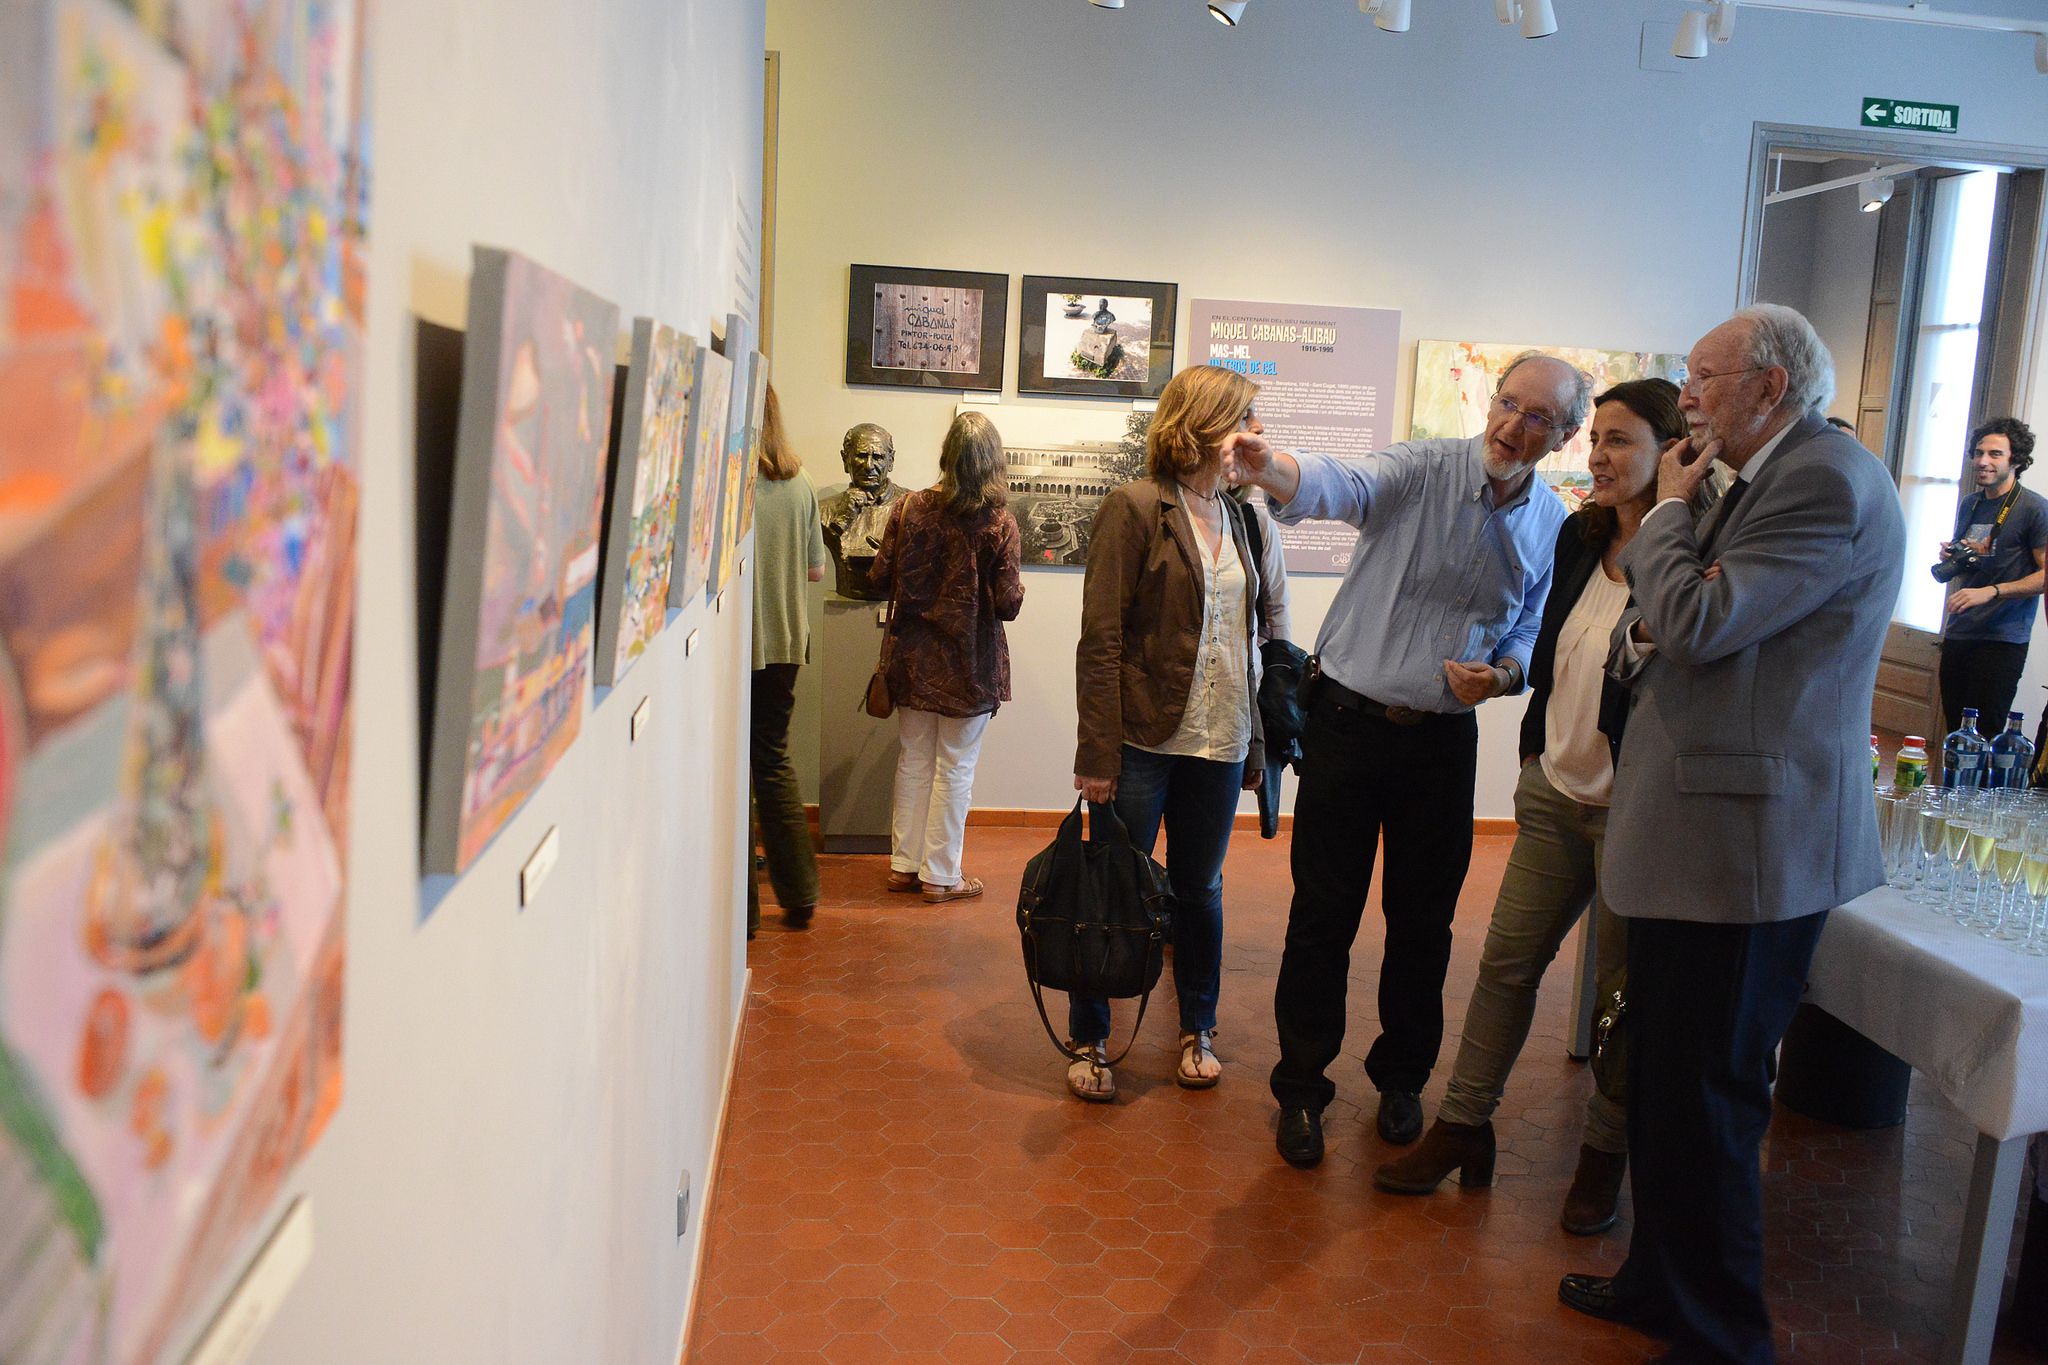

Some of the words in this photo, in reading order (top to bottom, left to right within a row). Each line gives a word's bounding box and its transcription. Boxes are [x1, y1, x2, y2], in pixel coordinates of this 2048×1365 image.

[1894, 105, 1951, 128] SORTIDA
[908, 313, 958, 330] CABANAS
[1210, 322, 1249, 341] MIQUEL
[1251, 324, 1337, 345] CABANAS-ALIBAU
[1209, 344, 1251, 359] MAS-MEL
[1301, 345, 1334, 353] 1916-1995
[1249, 360, 1260, 375] DE
[1262, 360, 1279, 375] CEL
